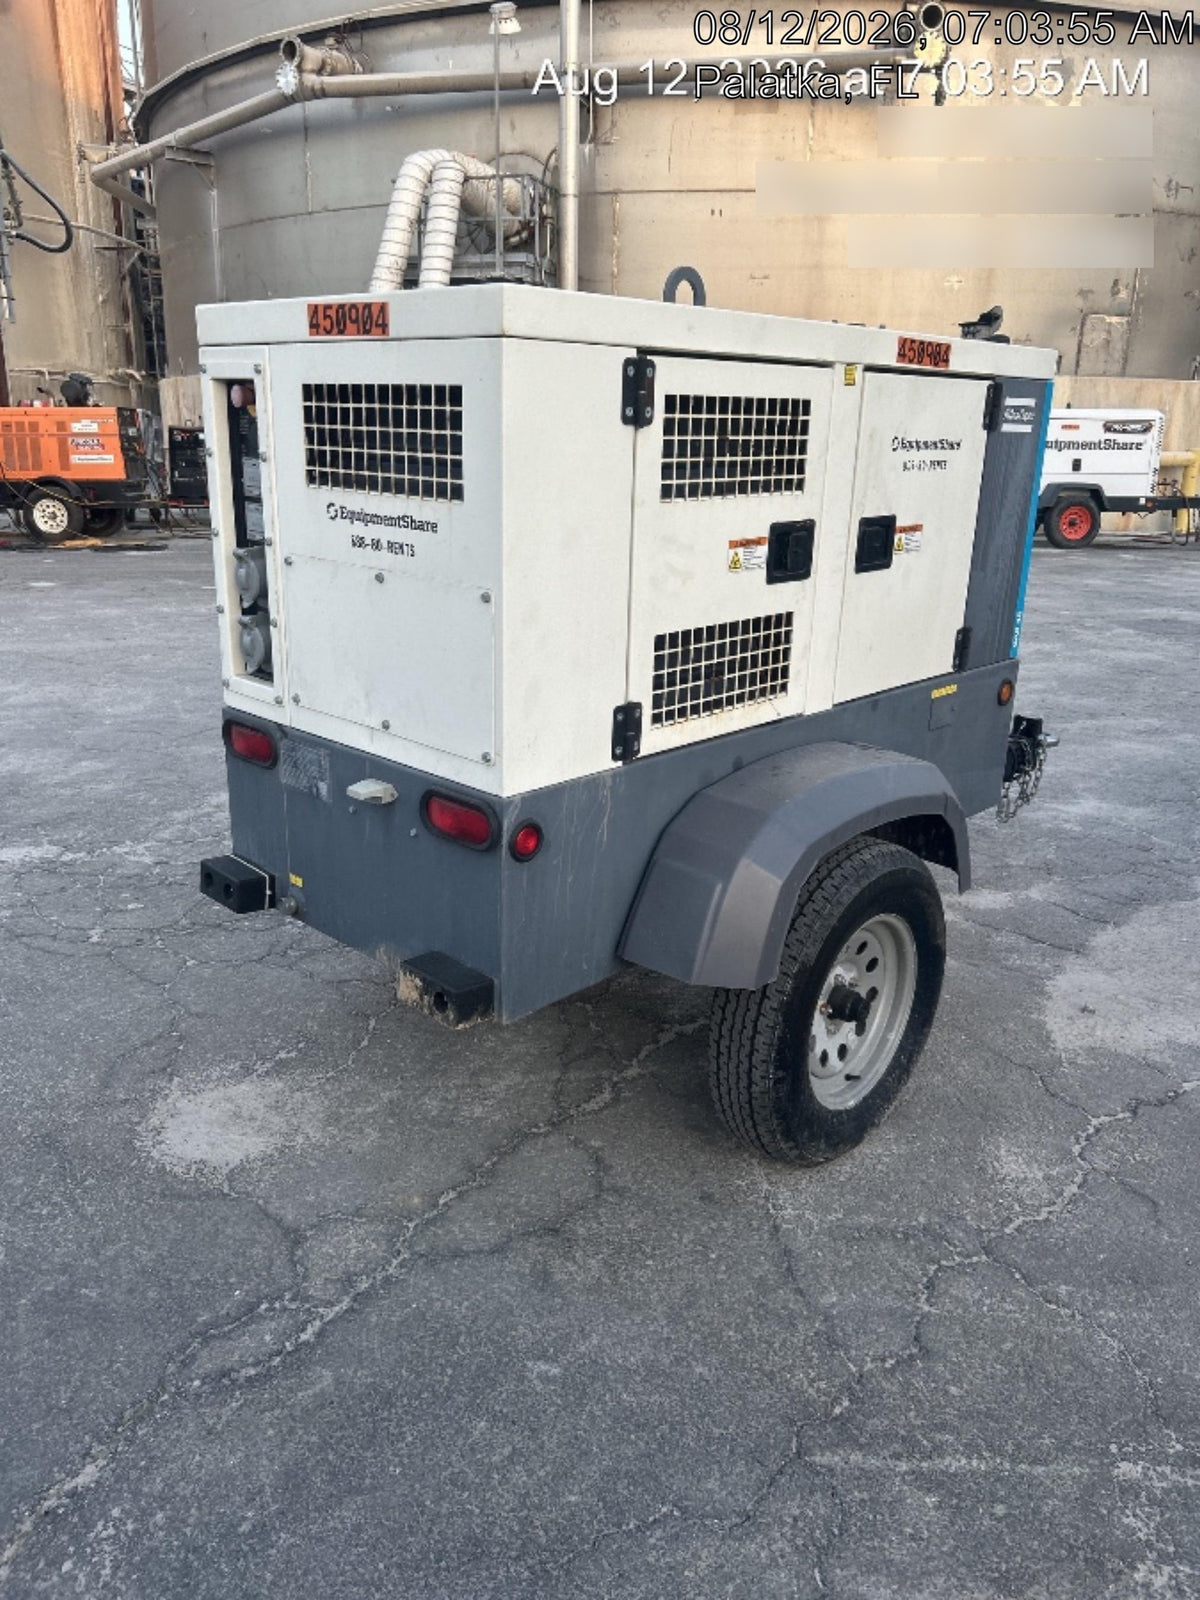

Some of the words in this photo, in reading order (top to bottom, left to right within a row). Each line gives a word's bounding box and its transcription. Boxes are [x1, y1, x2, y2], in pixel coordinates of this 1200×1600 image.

[309, 302, 388, 335] 450904
[897, 337, 951, 366] 450904
[339, 504, 439, 534] EquipmentShare
